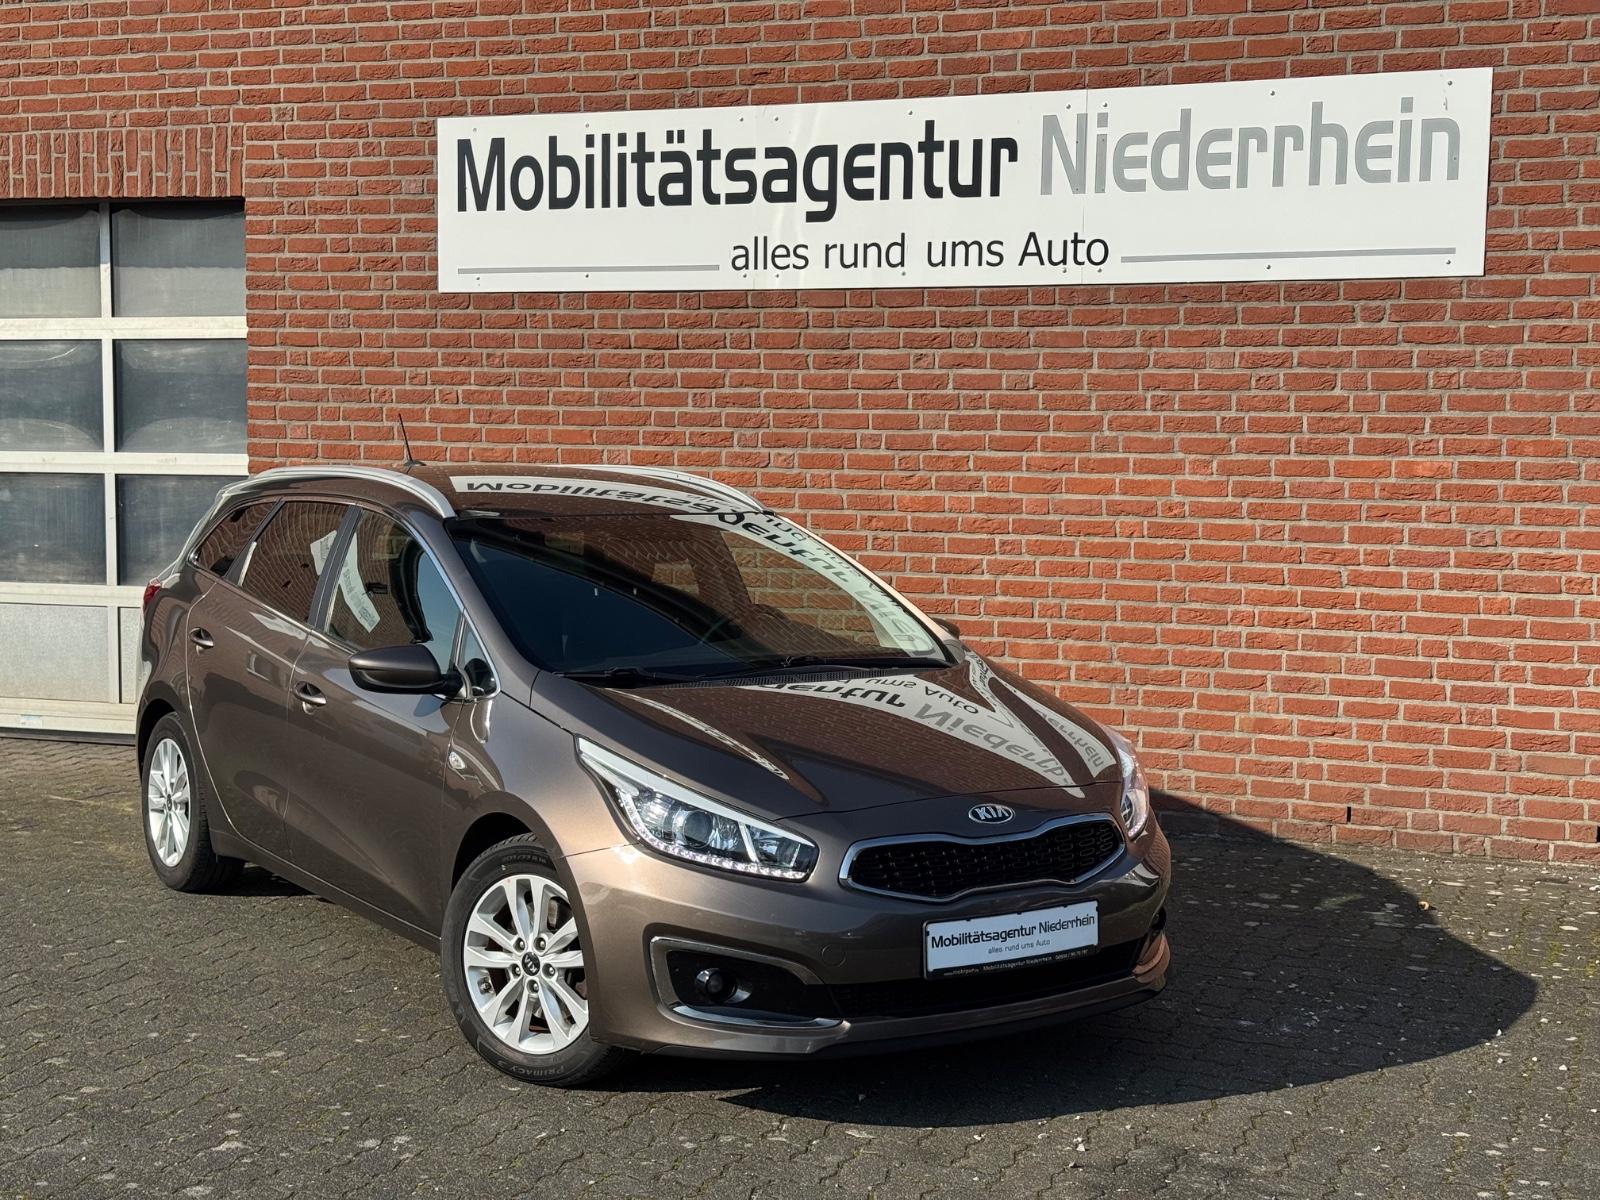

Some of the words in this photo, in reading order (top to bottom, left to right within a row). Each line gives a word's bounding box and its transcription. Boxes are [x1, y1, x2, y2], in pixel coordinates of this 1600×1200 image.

[458, 120, 1018, 222] Mobilitätsagentur
[1041, 97, 1461, 195] Niederrhein
[731, 236, 809, 271] alles
[825, 233, 906, 269] rund
[928, 241, 1004, 268] ums
[1018, 232, 1109, 267] Auto
[974, 805, 1010, 820] KIA
[931, 924, 1037, 949] Mobilitätsagentur
[1038, 914, 1095, 934] Niederrhein
[988, 946, 1003, 954] alles
[1005, 943, 1019, 952] rund
[1021, 941, 1034, 949] ums
[1036, 939, 1051, 947] Auto
